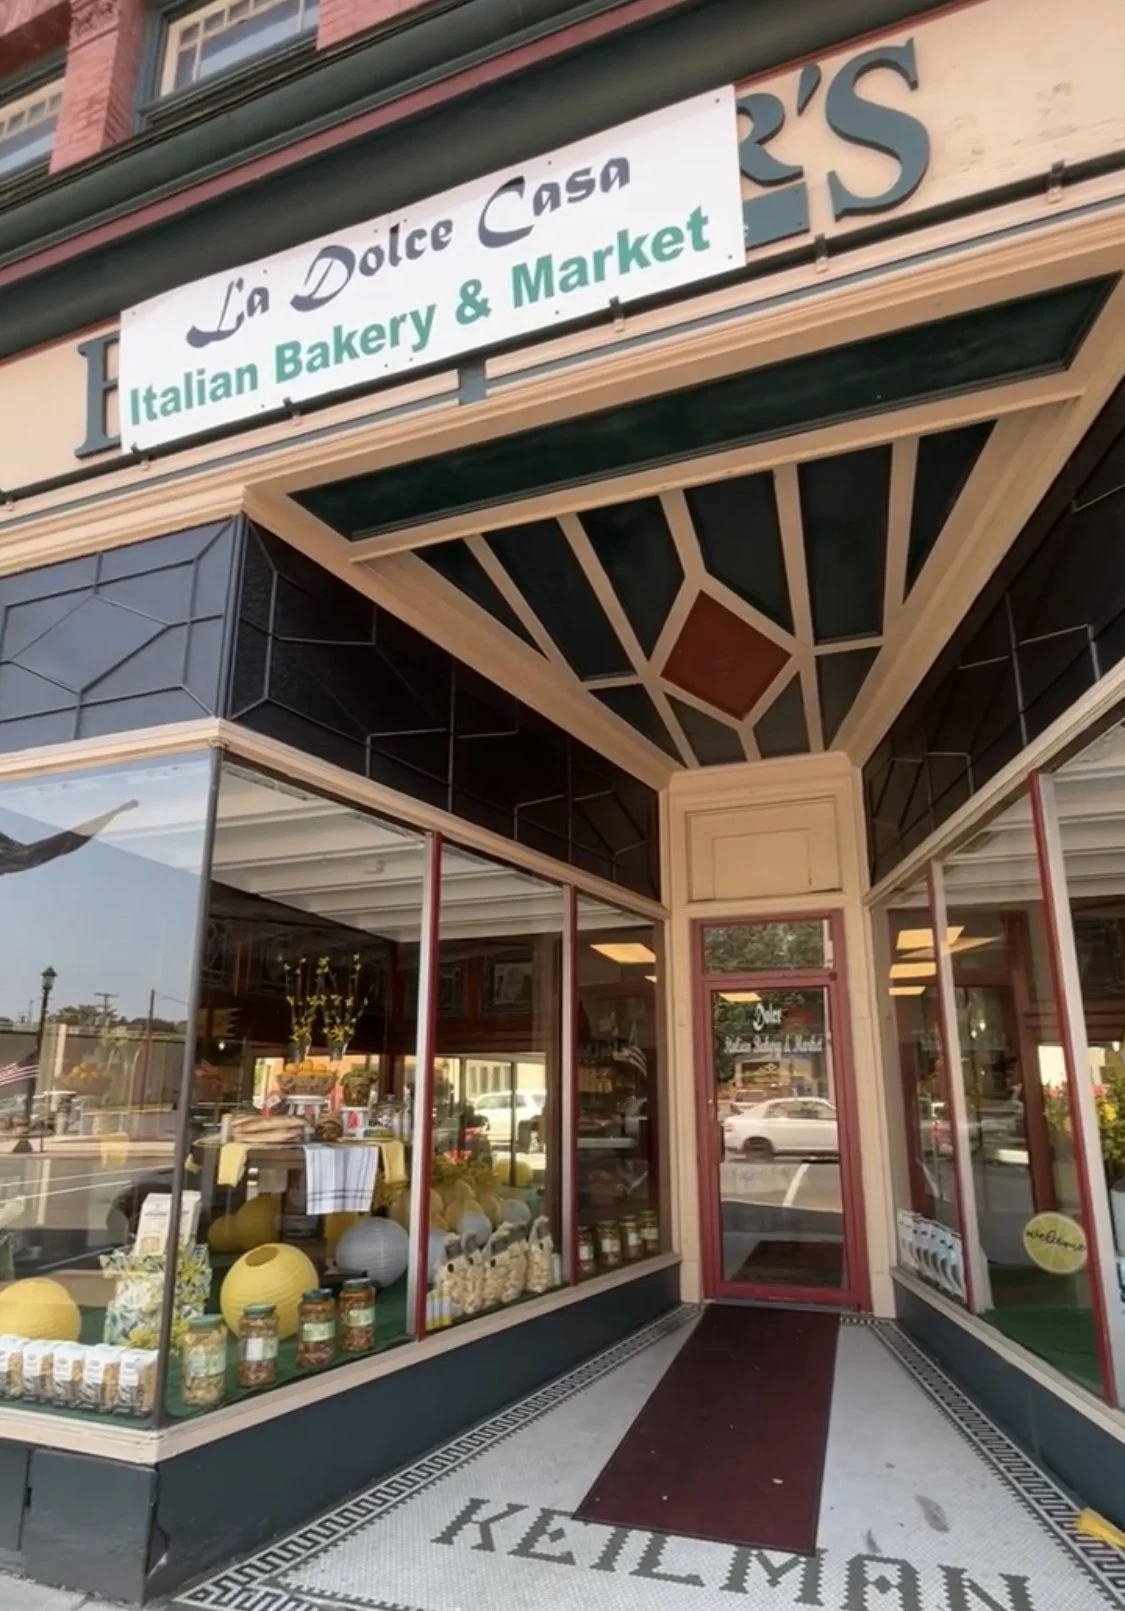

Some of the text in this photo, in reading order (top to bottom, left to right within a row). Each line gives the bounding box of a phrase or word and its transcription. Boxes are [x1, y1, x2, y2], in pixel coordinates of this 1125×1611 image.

[130, 363, 258, 426] Italian
[275, 304, 436, 384] Bakery
[455, 278, 492, 325] &
[511, 205, 710, 308] Market
[186, 156, 630, 348] La Dolce Casa
